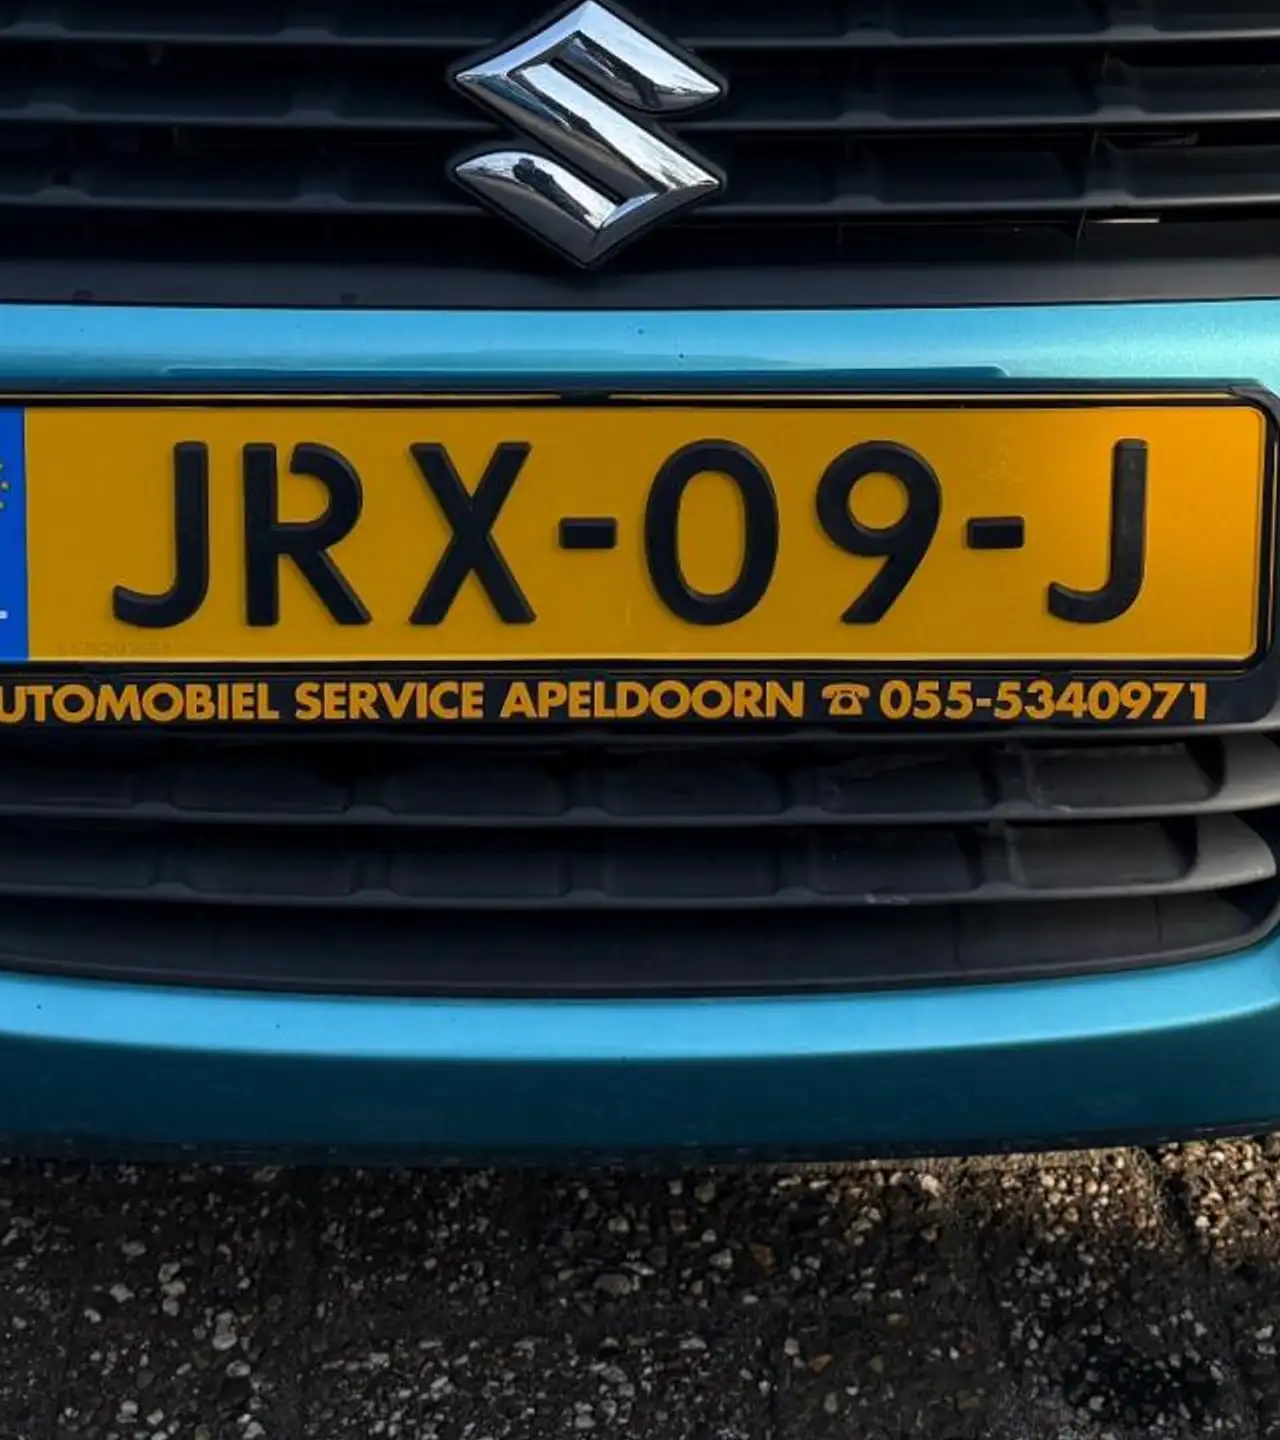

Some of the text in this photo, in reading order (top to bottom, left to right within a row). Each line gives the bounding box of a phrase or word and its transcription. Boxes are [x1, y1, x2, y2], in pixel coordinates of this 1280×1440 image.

[112, 438, 1148, 628] JRX-09-J
[295, 681, 483, 721] SERVICE
[501, 680, 804, 720] APELDOORN
[880, 680, 1208, 720] 055-5340971
